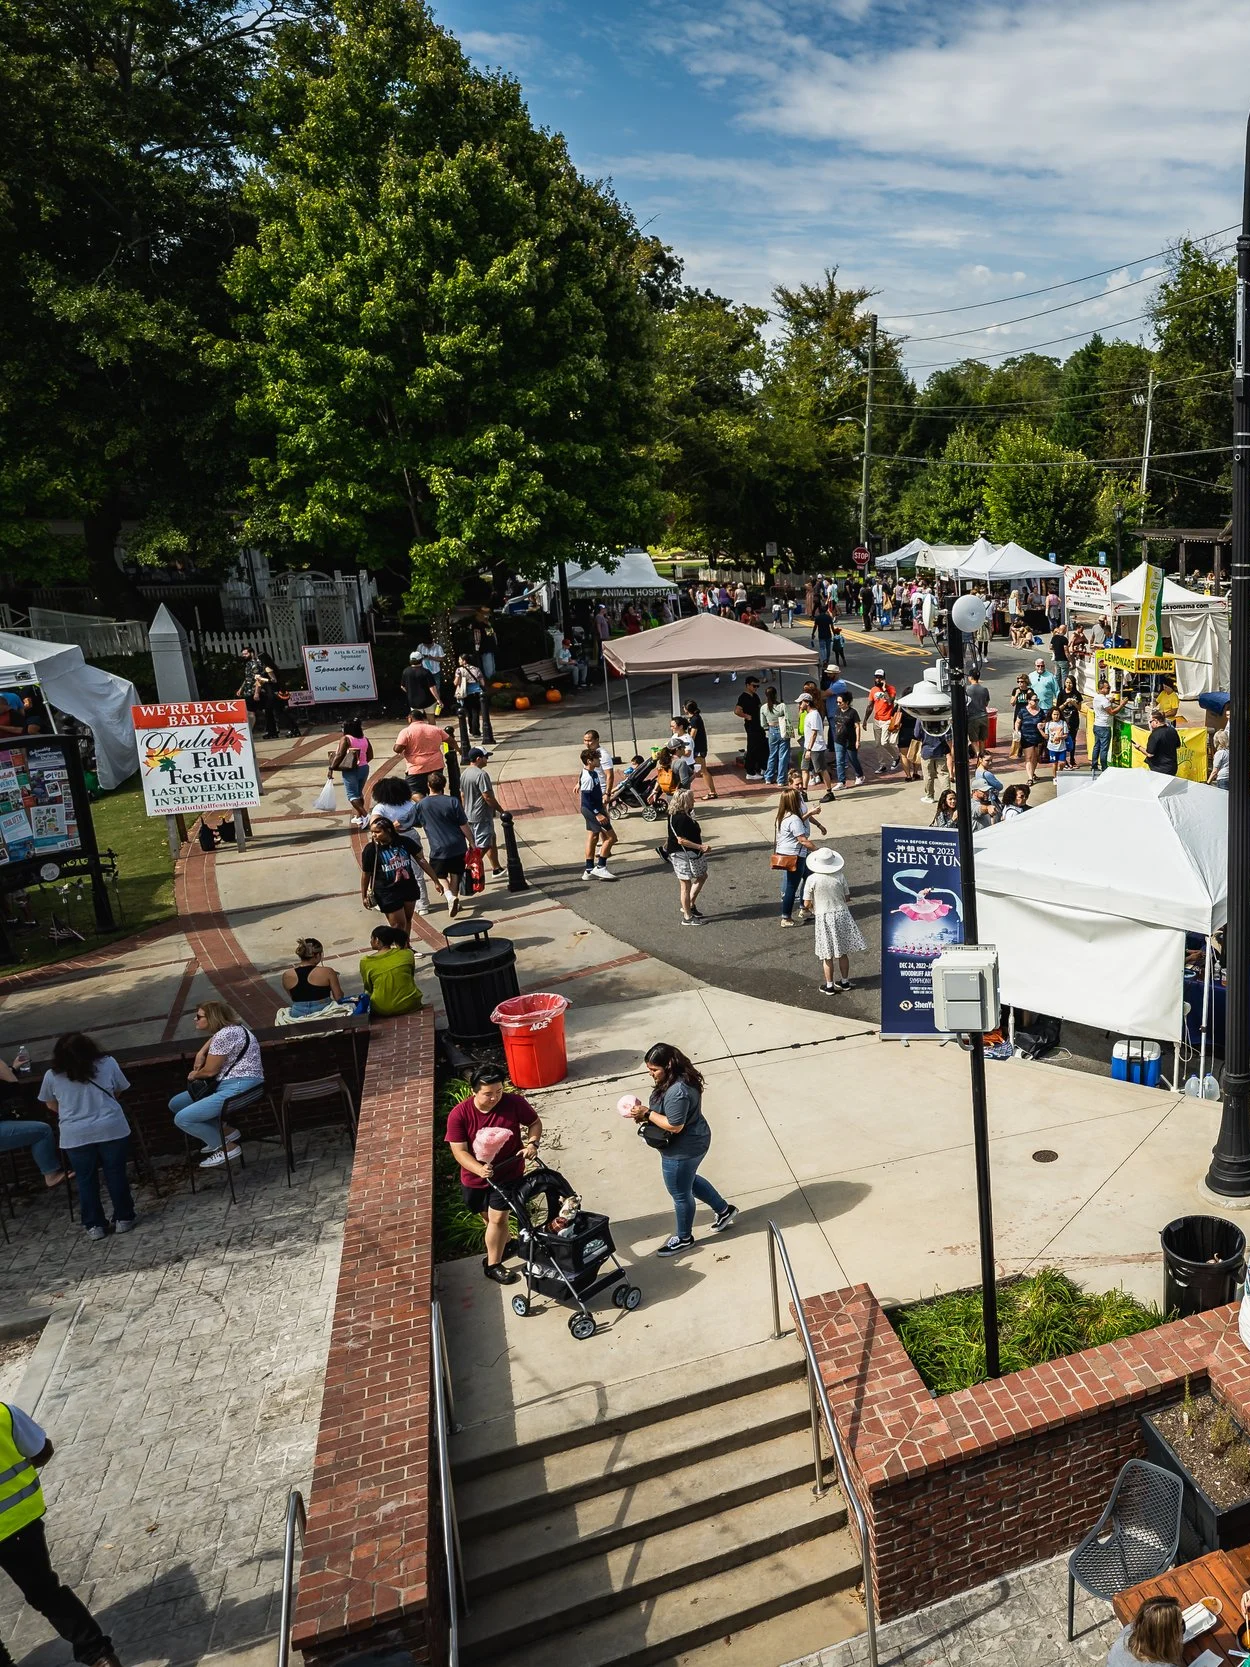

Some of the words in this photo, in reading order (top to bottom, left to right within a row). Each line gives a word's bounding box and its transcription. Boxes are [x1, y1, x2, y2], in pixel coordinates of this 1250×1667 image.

[602, 588, 634, 597] ANIMAL
[636, 588, 676, 596] HOSPITAL
[1104, 652, 1134, 670] LEMONADE
[1138, 659, 1173, 672] LEMONADE
[315, 665, 355, 674] Sponsored
[140, 704, 190, 717] WE'RE
[194, 701, 238, 713] BACK
[168, 714, 215, 726] BABY!
[141, 727, 237, 758] Duluth
[191, 752, 233, 769] Fall
[169, 766, 245, 786] Festival
[152, 786, 185, 797] LAST
[188, 781, 254, 794] WEEKEND
[155, 797, 170, 806] IN
[173, 791, 254, 806] SEPTEMBER
[153, 801, 257, 814] www.duluthfallfestival.com
[381, 860, 410, 872] Marlbor
[887, 852, 928, 864] SHEN
[932, 854, 961, 867] YUN
[530, 1020, 548, 1031] ACE
